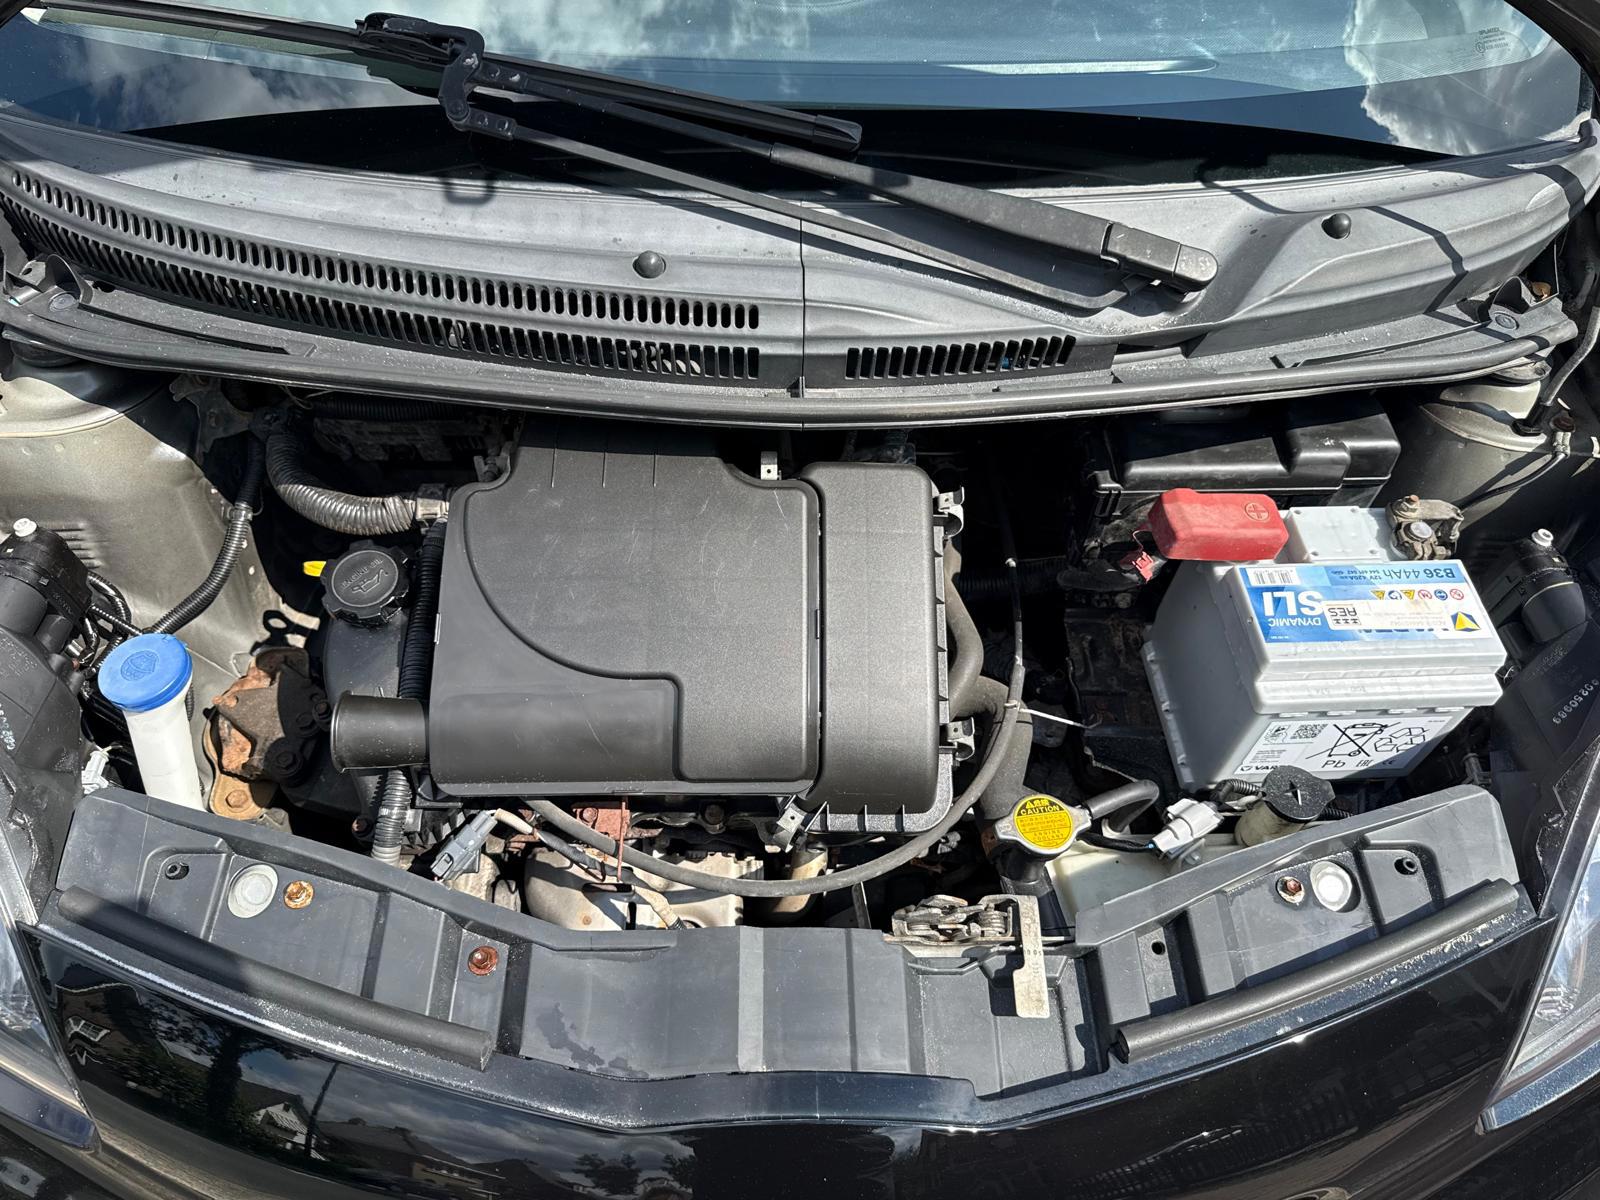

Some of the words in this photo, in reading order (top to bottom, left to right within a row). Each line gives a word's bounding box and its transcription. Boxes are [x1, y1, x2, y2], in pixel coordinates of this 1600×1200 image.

[341, 566, 369, 589] ENGINE
[369, 559, 384, 569] OIL
[1382, 569, 1421, 580] 44Ah
[1423, 568, 1457, 579] B36
[1262, 590, 1325, 617] SLI
[1268, 617, 1322, 627] DYNAMIC
[1321, 759, 1346, 769] Pb
[1020, 804, 1060, 816] CAUTION
